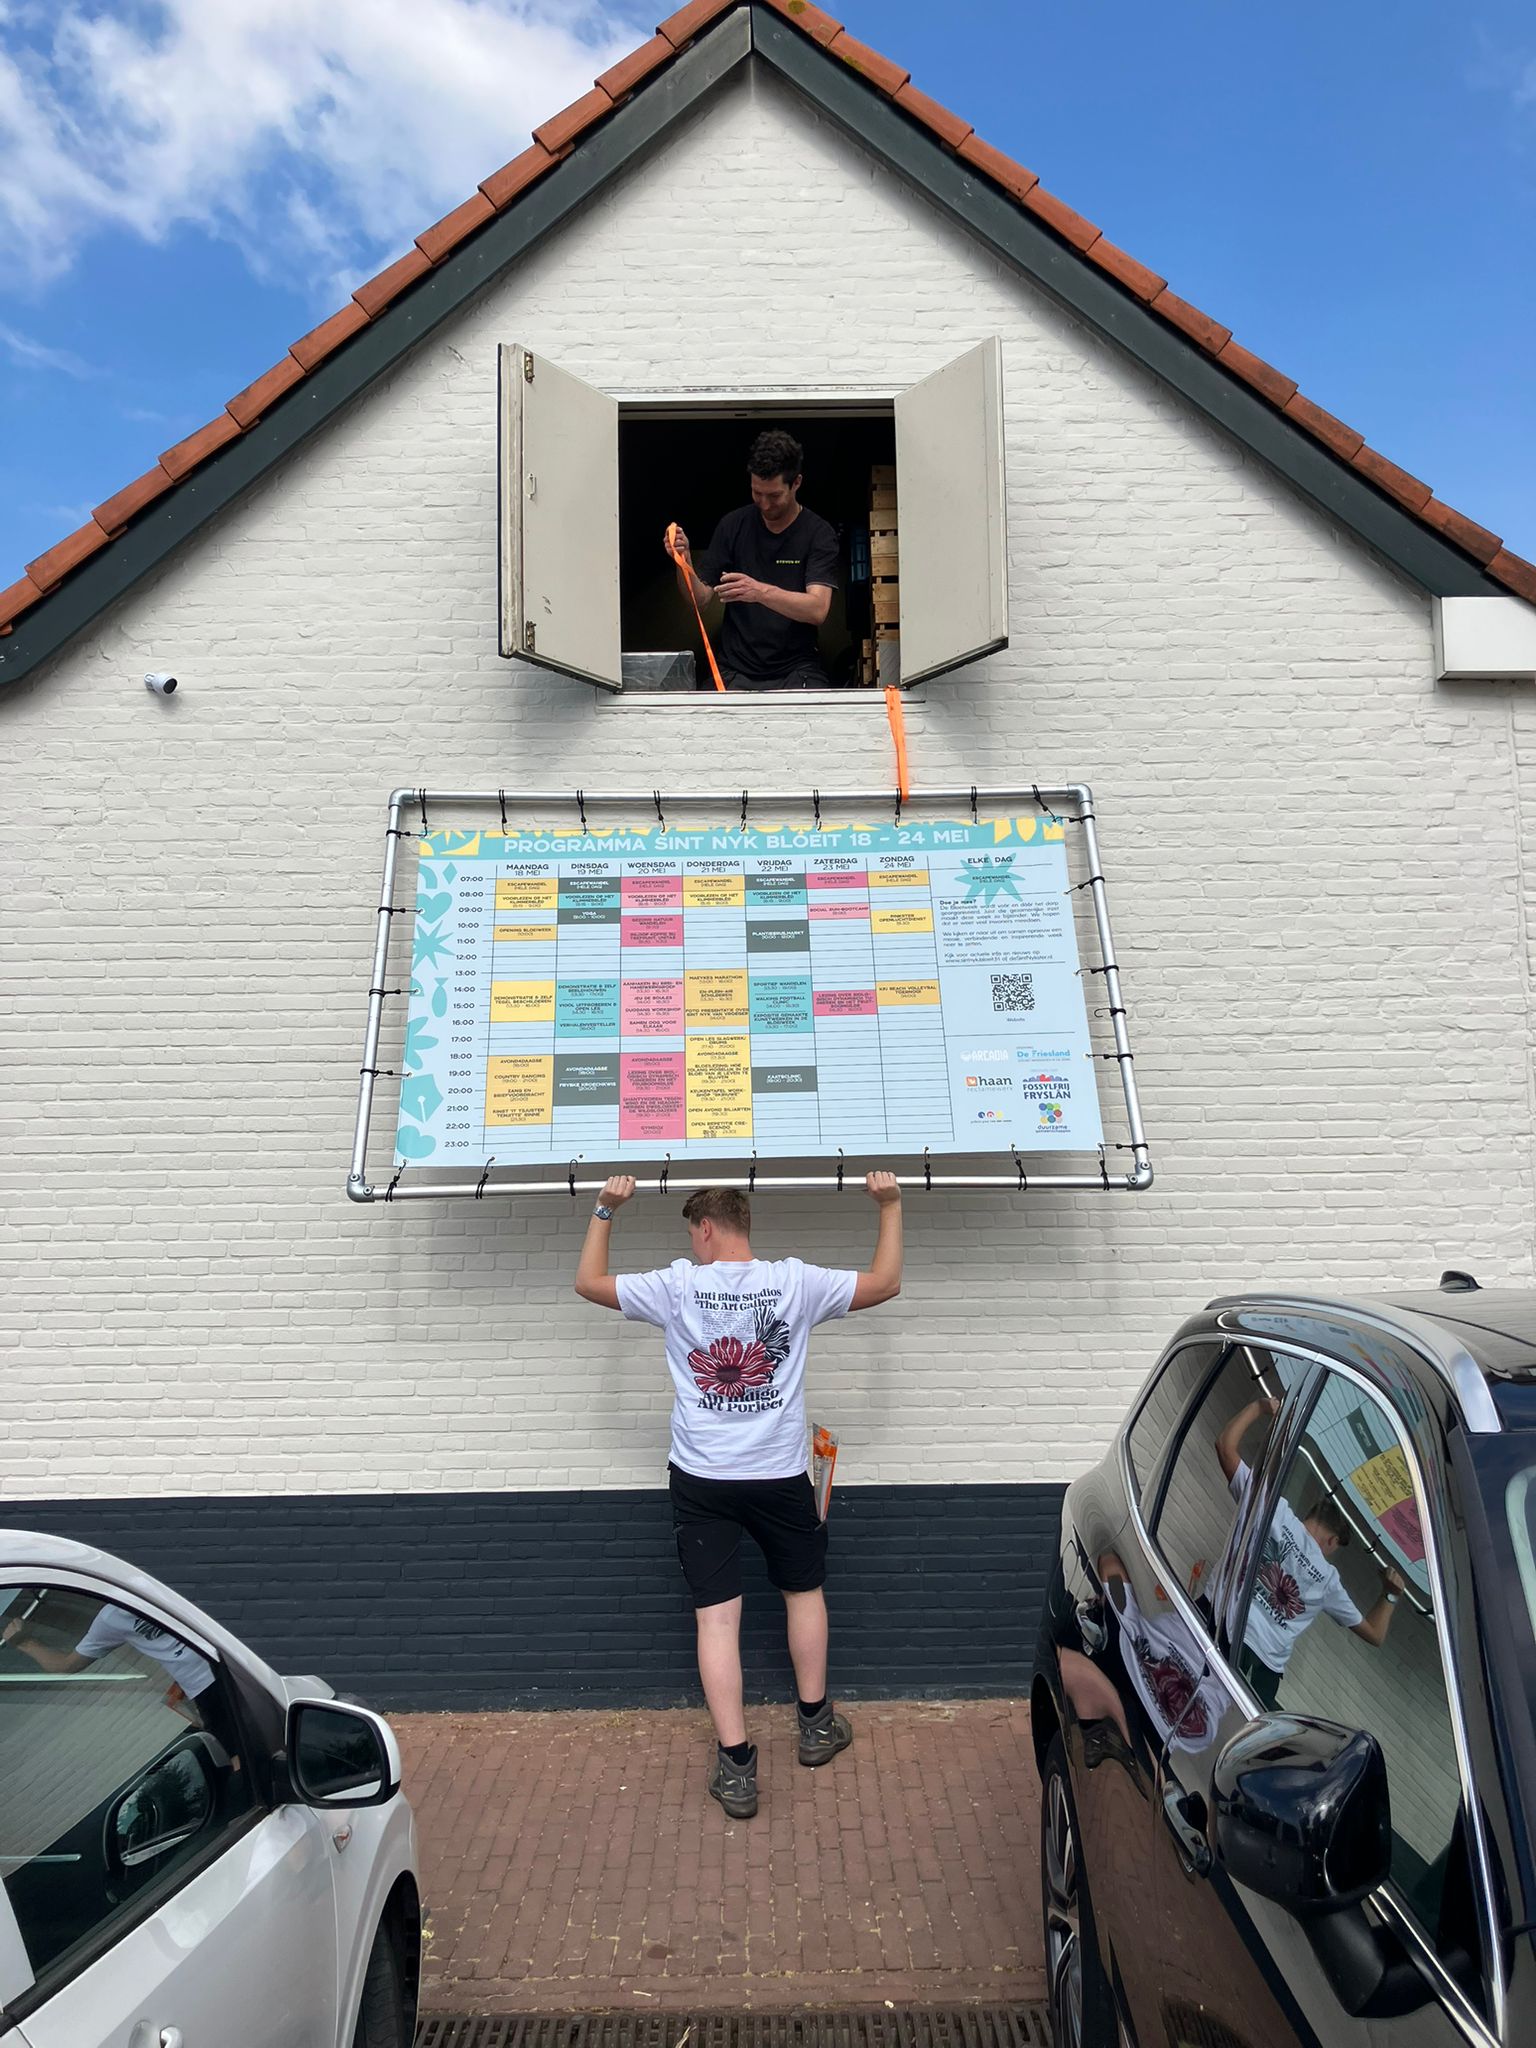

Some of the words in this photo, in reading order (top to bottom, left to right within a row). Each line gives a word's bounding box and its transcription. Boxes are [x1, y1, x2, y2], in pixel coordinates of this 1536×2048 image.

[504, 837, 646, 853] PROGRAMMA
[654, 835, 705, 850] SINT
[712, 835, 759, 849] NYK
[766, 833, 842, 848] BLOEIT
[849, 833, 872, 847] 18
[898, 831, 926, 845] 24
[933, 829, 970, 844] MEI
[813, 857, 858, 865] ZATERDAG
[879, 855, 915, 863] ZONDAG
[994, 855, 1014, 863] DAG
[1031, 1049, 1071, 1058] Friesland
[978, 1076, 1013, 1086] haan
[1023, 1083, 1070, 1091] FOSSYLFRIJ
[694, 1290, 716, 1301] Anti
[718, 1292, 741, 1302] Blue
[742, 1288, 782, 1302] Studios
[721, 1302, 739, 1311] Art
[739, 1298, 779, 1312] Gallery
[697, 1398, 725, 1412] Art
[725, 1396, 784, 1414] Porject
